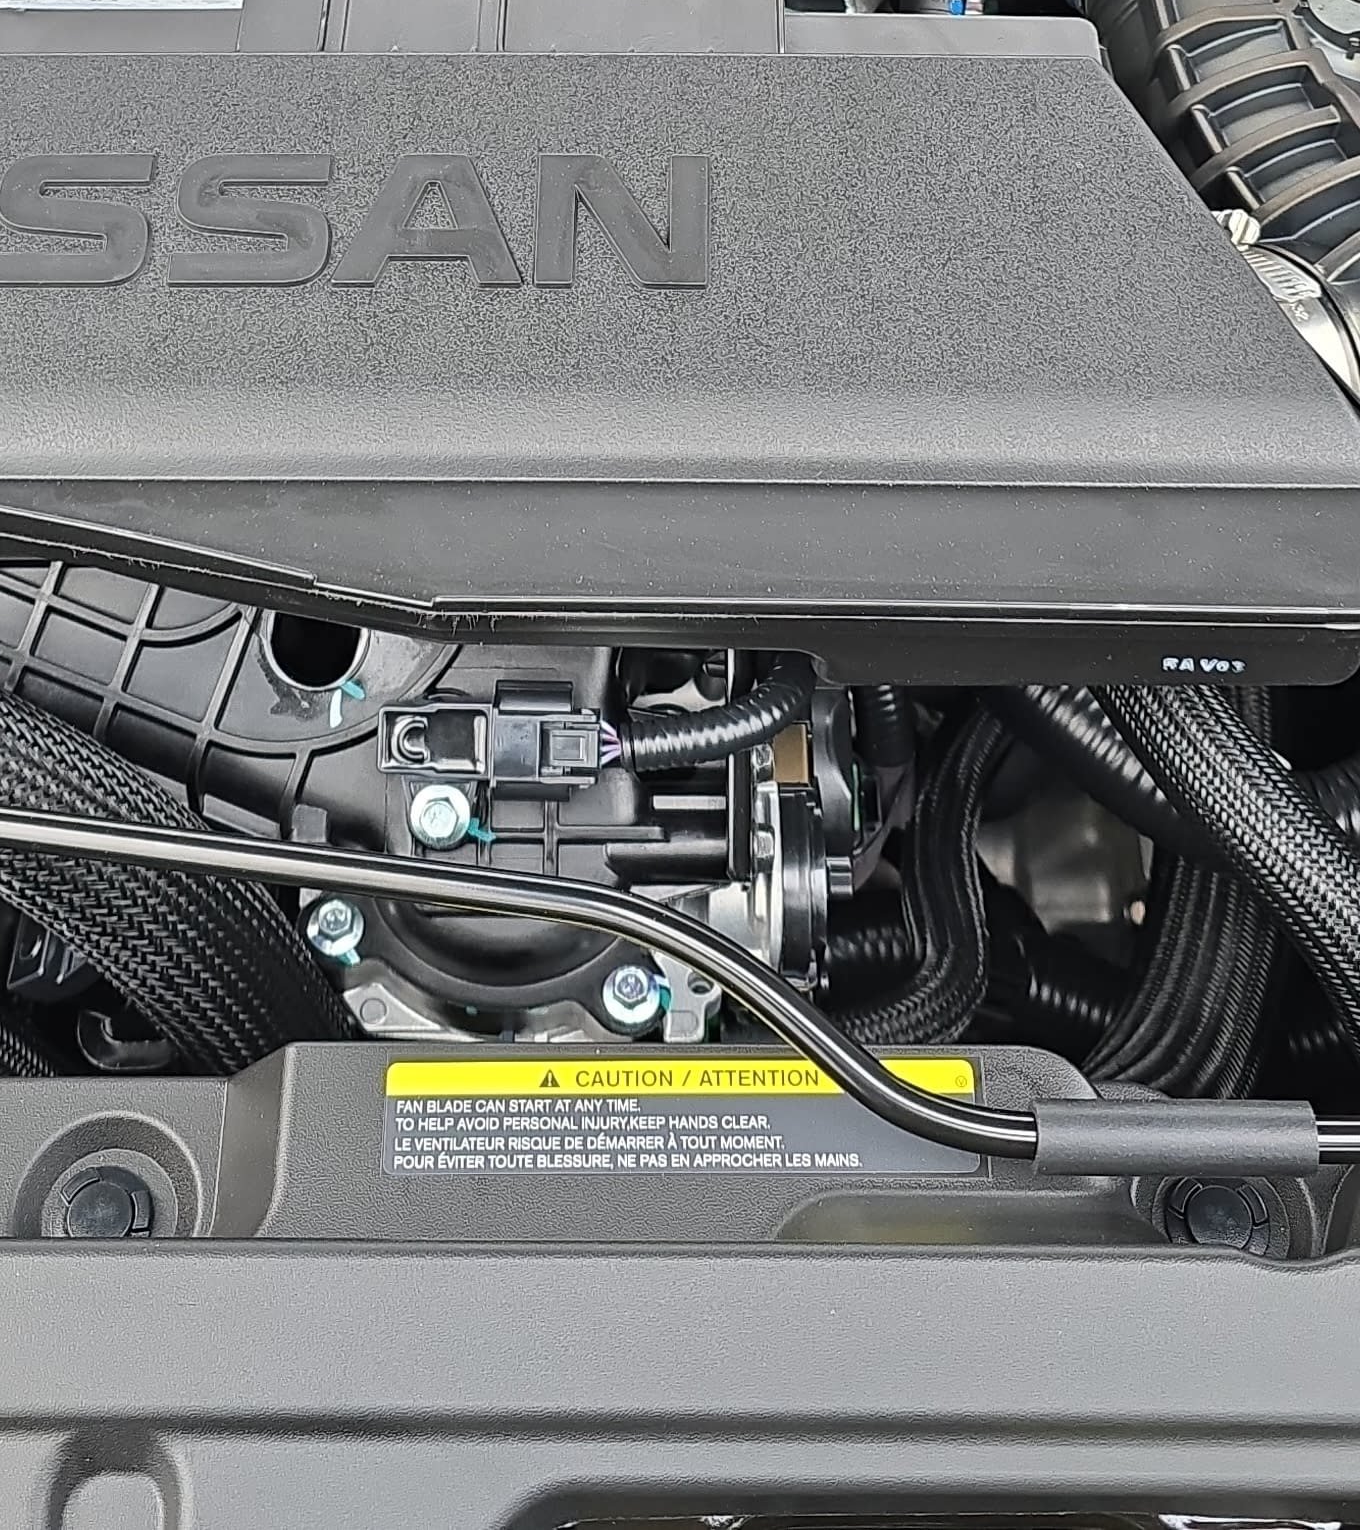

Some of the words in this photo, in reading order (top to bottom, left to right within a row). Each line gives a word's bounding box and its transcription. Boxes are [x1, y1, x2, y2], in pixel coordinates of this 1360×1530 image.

[576, 1070, 673, 1087] CAUTION
[682, 1070, 691, 1087] /
[700, 1070, 819, 1087] ATTENTION
[396, 1100, 423, 1113] FAN
[427, 1100, 472, 1113] BLADE
[476, 1099, 505, 1113] CAN
[509, 1099, 552, 1113] START
[555, 1099, 572, 1113] AT
[574, 1099, 602, 1113] ANY
[606, 1099, 641, 1113] TIME.
[396, 1117, 414, 1131] TO
[418, 1117, 454, 1130] HELP
[457, 1117, 499, 1130] AVOID
[504, 1116, 578, 1130] PERSONAL
[669, 1116, 718, 1129] HANDS
[722, 1115, 770, 1129] CLEAR.
[395, 1137, 411, 1151] LE
[415, 1136, 505, 1151] VENTILATEUR
[509, 1136, 560, 1151] RISQUE
[564, 1136, 583, 1150] DE
[587, 1133, 664, 1150] DÉMARRER
[667, 1132, 677, 1149] À
[680, 1135, 717, 1149] TOUT
[720, 1135, 785, 1149] MOMENT.
[394, 1155, 434, 1169] POUR
[439, 1151, 484, 1169] ÉVITER
[489, 1155, 533, 1168] TOUTE
[537, 1155, 613, 1170] BLESSURE,
[617, 1155, 637, 1168] NE
[640, 1154, 667, 1168] PAS
[671, 1154, 690, 1167] EN
[693, 1154, 782, 1167] APPROCHER
[785, 1154, 812, 1167] LES
[815, 1153, 862, 1167] MAINS.
